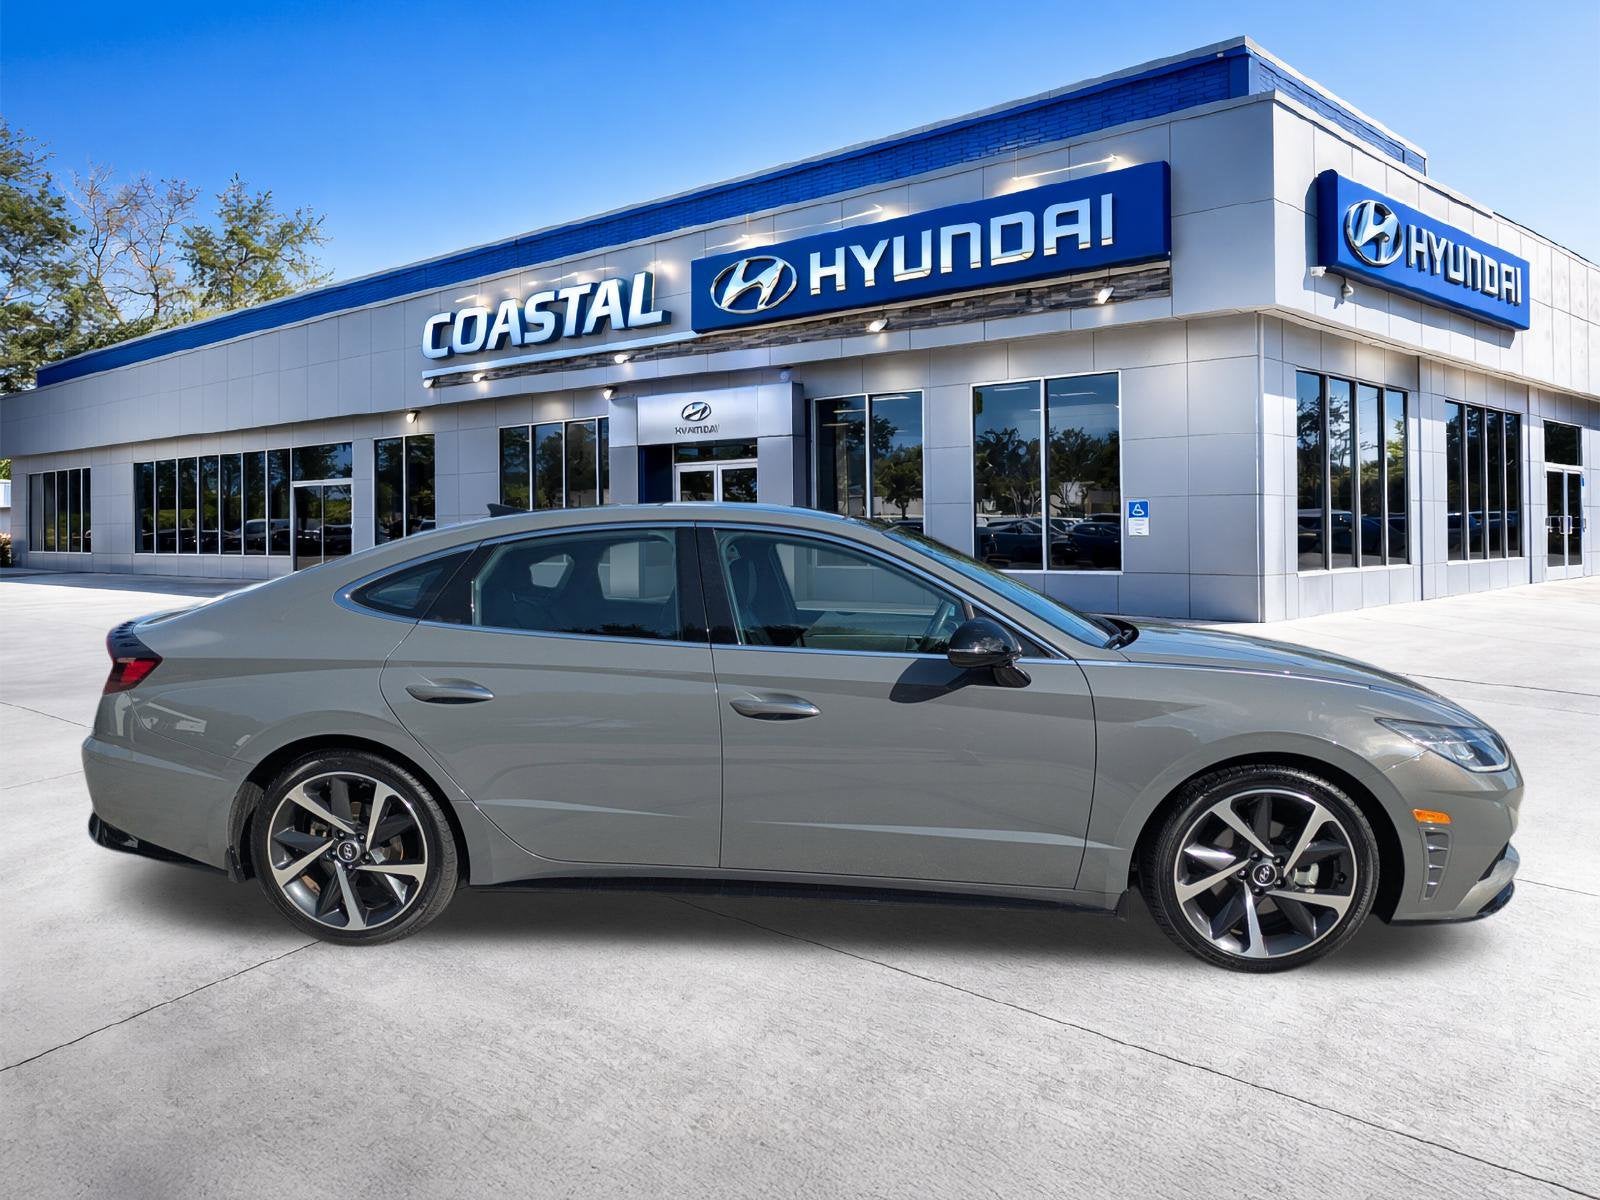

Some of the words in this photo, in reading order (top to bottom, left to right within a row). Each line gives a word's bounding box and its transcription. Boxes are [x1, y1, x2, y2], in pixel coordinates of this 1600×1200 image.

[809, 193, 1113, 295] HYUNDAI
[1406, 224, 1522, 306] HYUNDAI
[422, 271, 669, 359] COASTAL
